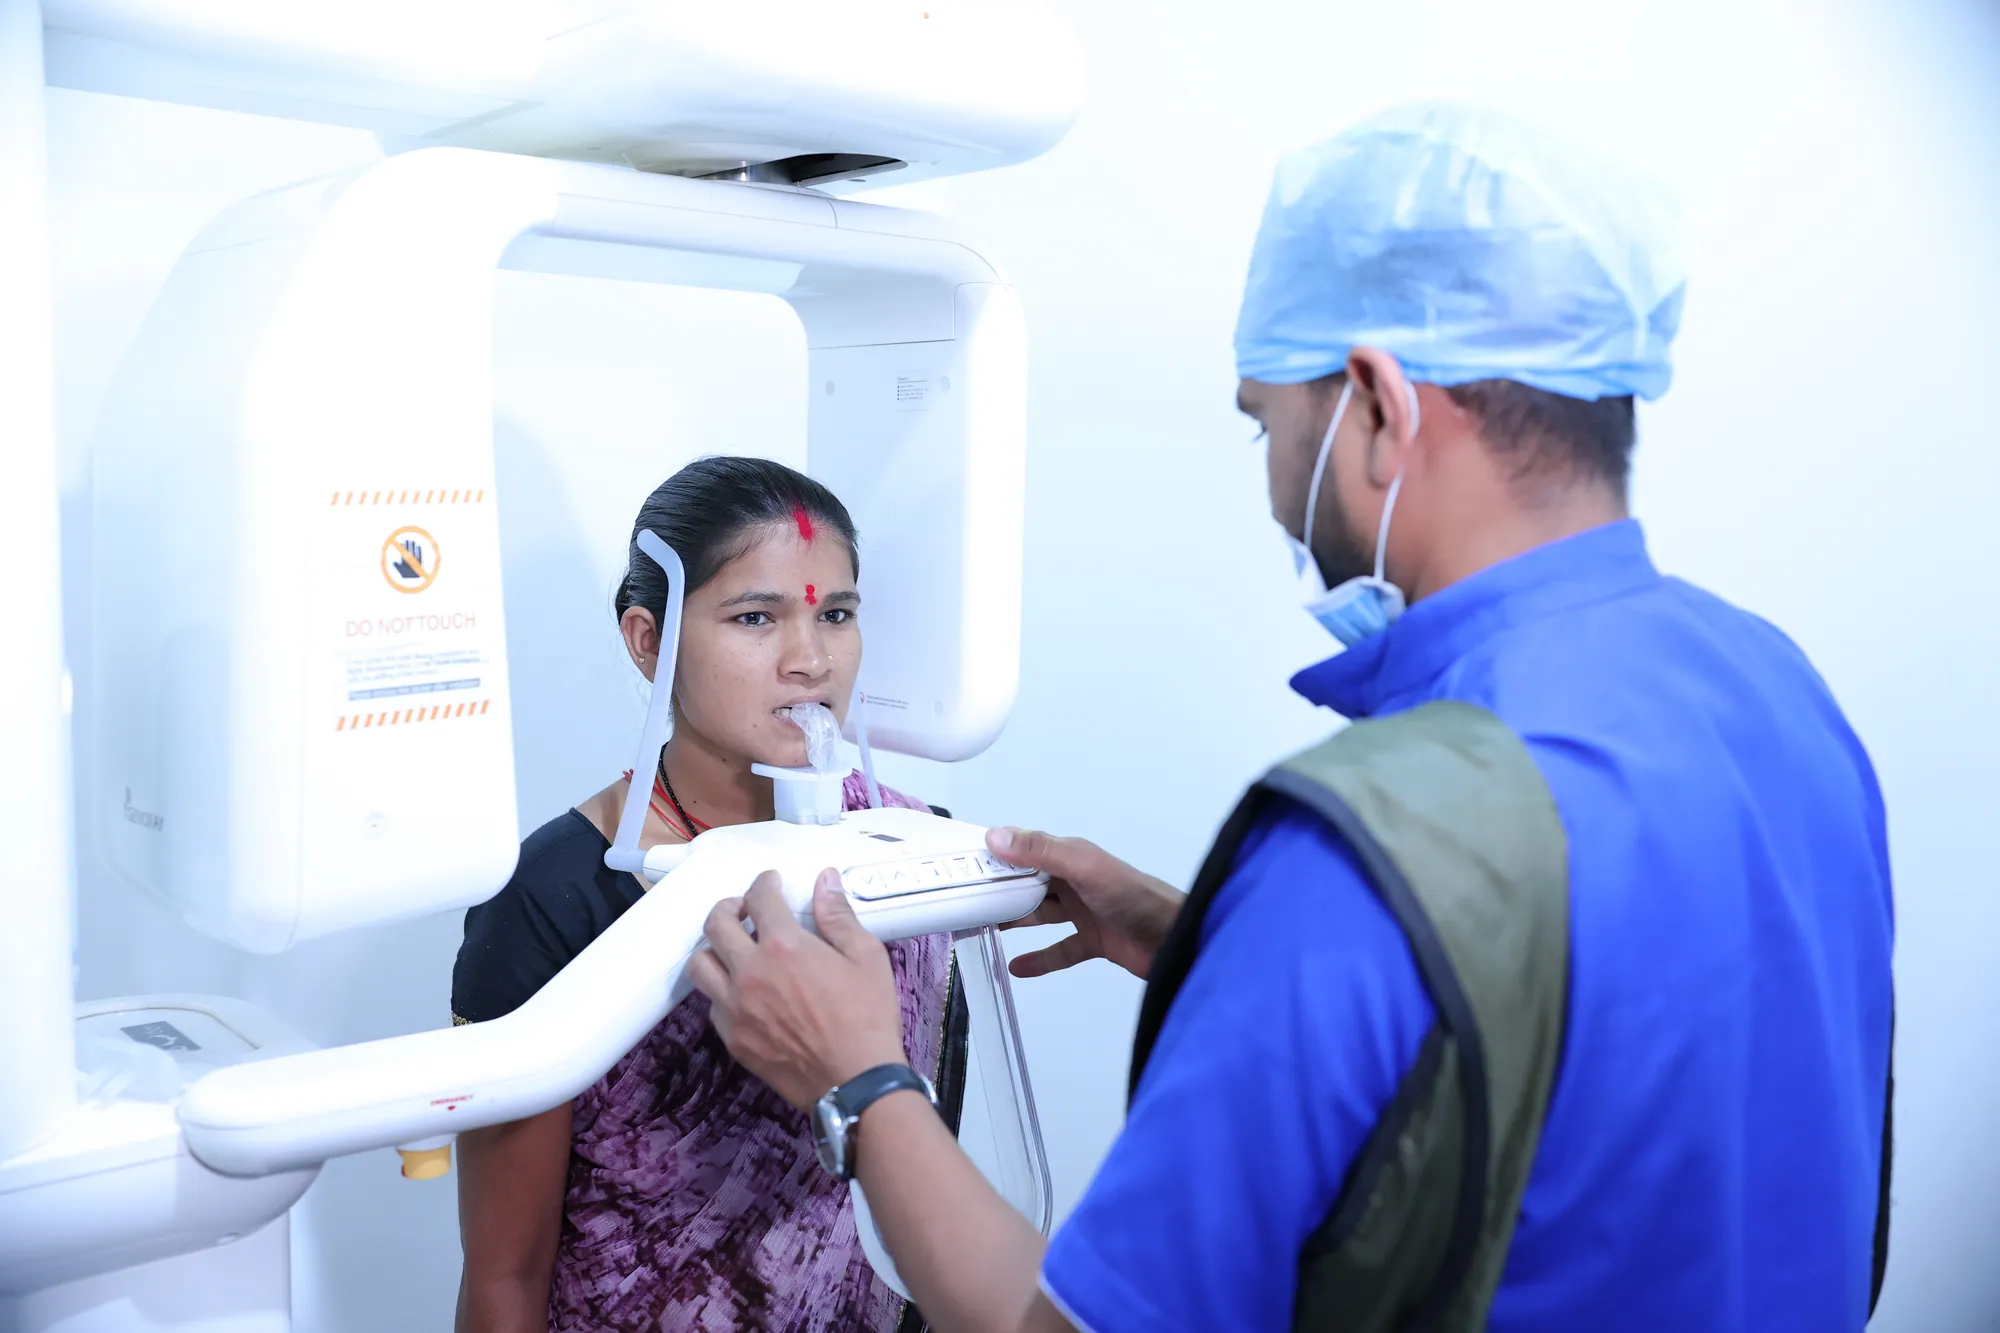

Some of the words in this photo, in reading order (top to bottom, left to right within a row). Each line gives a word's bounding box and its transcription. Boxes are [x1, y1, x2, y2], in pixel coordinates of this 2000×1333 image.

[345, 619, 373, 637] DO
[378, 616, 415, 635] NOT
[417, 612, 476, 632] TOUCH
